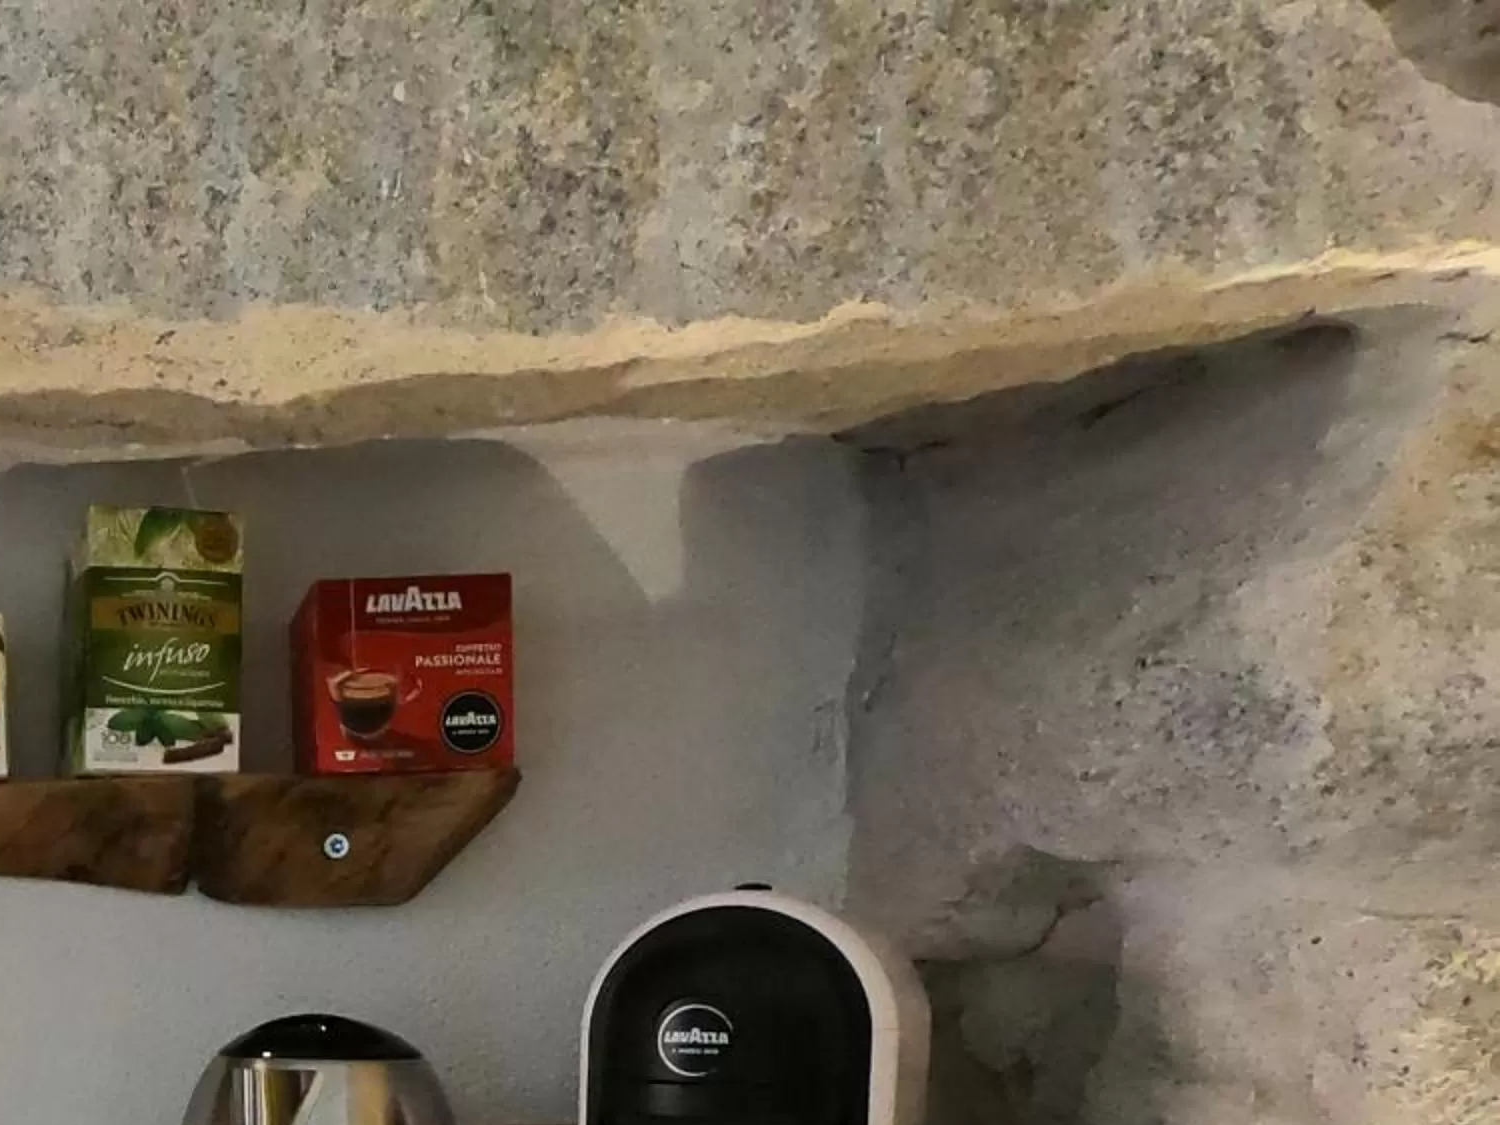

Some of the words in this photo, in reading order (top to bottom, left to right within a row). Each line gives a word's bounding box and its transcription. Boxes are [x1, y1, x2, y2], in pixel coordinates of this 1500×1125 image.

[366, 585, 462, 613] LAVAZZA
[117, 601, 216, 628] TWININGS
[123, 637, 211, 682] infuso
[415, 653, 501, 668] PASSIONALE
[445, 711, 497, 727] LAVAZZA
[663, 1027, 729, 1044] LAVAZZA
